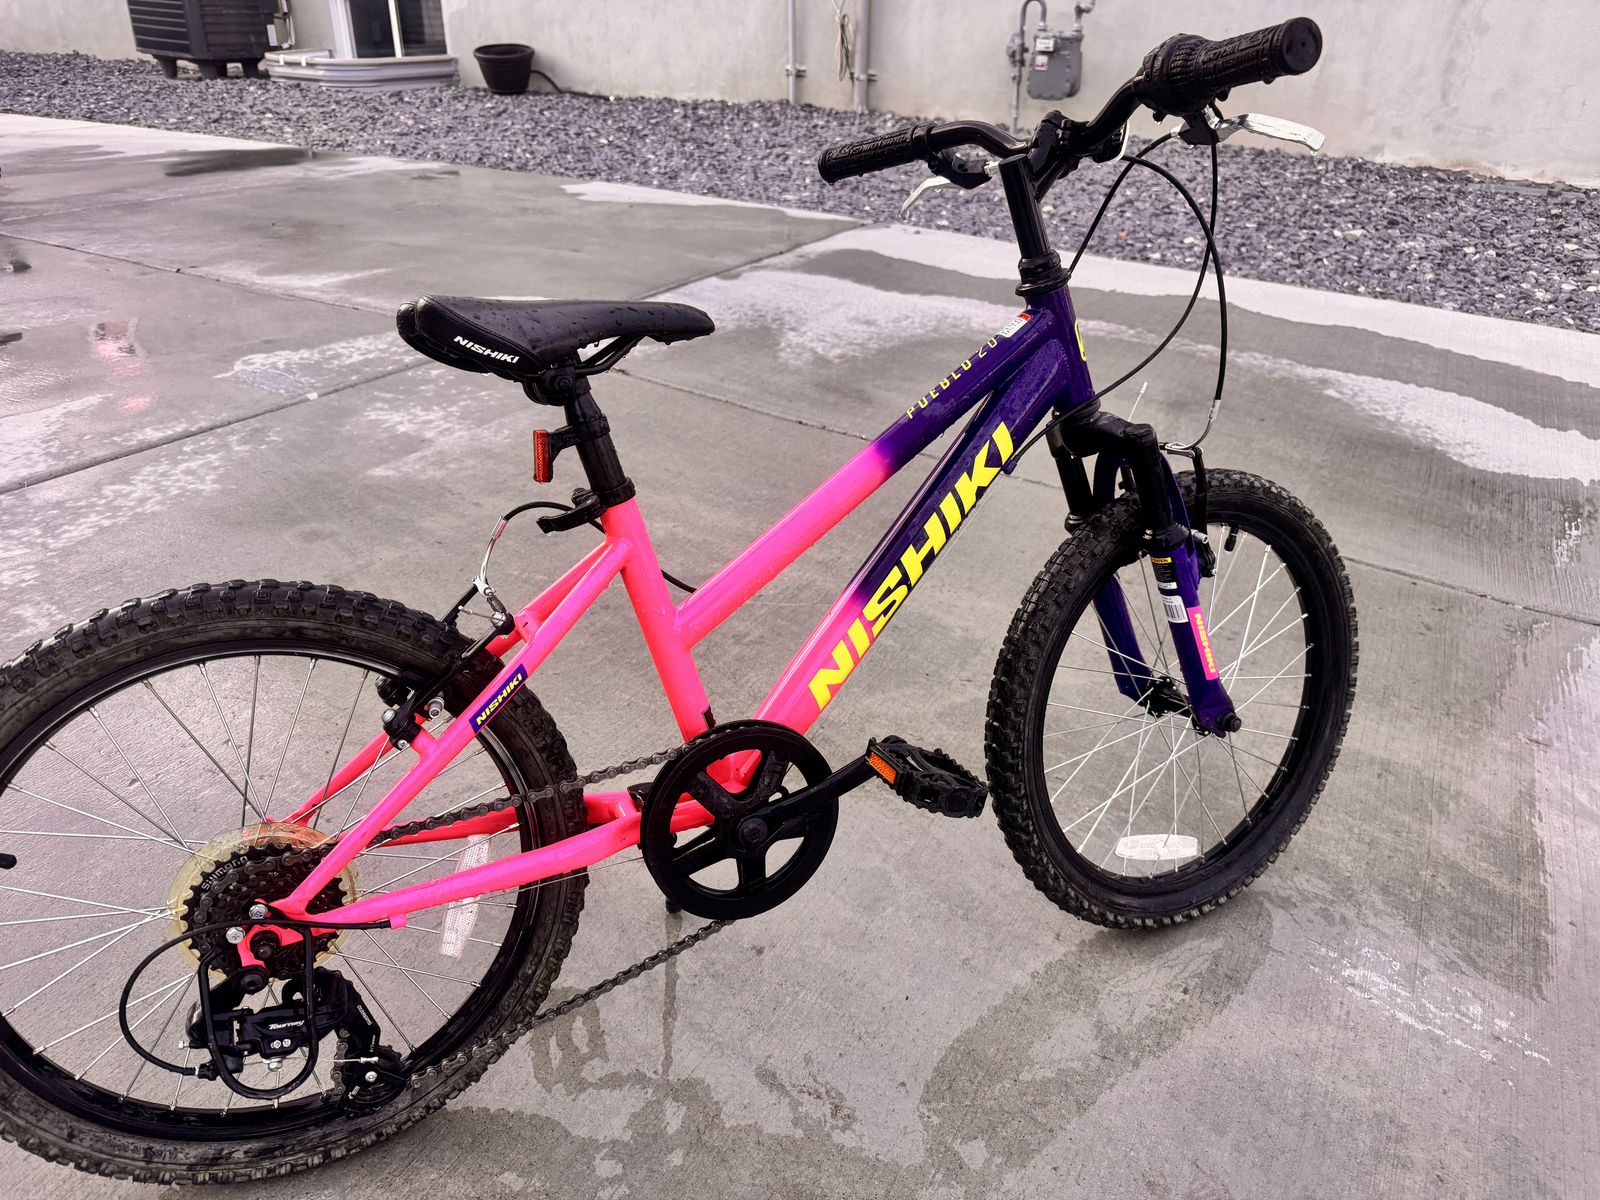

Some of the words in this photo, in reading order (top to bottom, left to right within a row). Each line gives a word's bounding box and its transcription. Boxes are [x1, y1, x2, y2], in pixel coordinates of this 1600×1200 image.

[453, 335, 520, 364] NISHIKI
[906, 359, 972, 419] PUEBLO
[808, 421, 1014, 711] NISHIKI
[1194, 613, 1216, 673] NISHIKI
[476, 673, 523, 725] NISHIKI
[269, 1020, 305, 1030] Tourney
